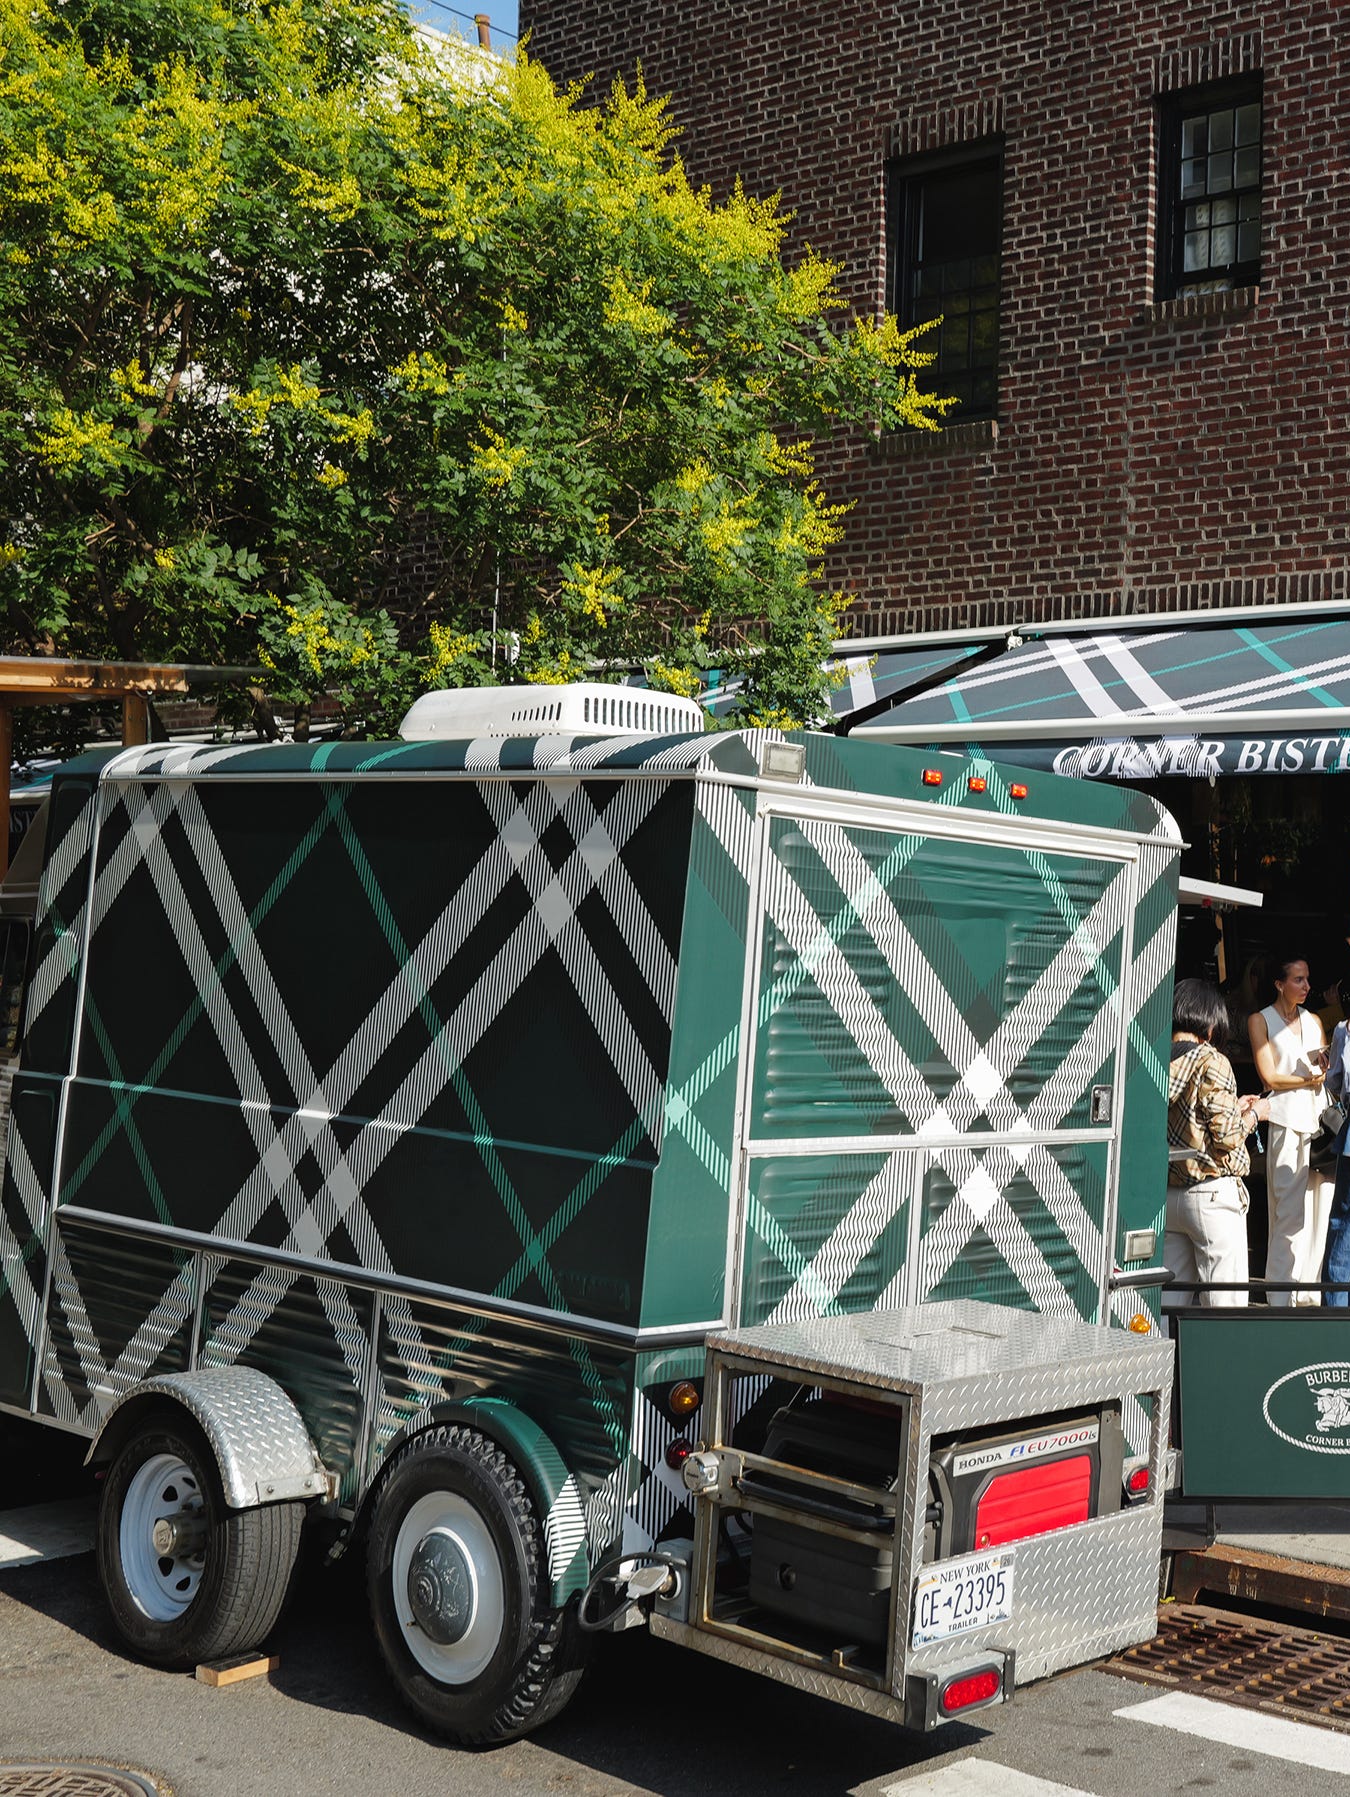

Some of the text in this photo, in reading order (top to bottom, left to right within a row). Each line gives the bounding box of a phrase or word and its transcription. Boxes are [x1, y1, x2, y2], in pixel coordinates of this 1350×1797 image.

[1053, 739, 1224, 777] CORNER
[1305, 1434, 1344, 1447] CORNER
[958, 1453, 1002, 1471] HONDA
[940, 1561, 991, 1584] NEW YORK
[948, 1617, 978, 1632] TRAILER
